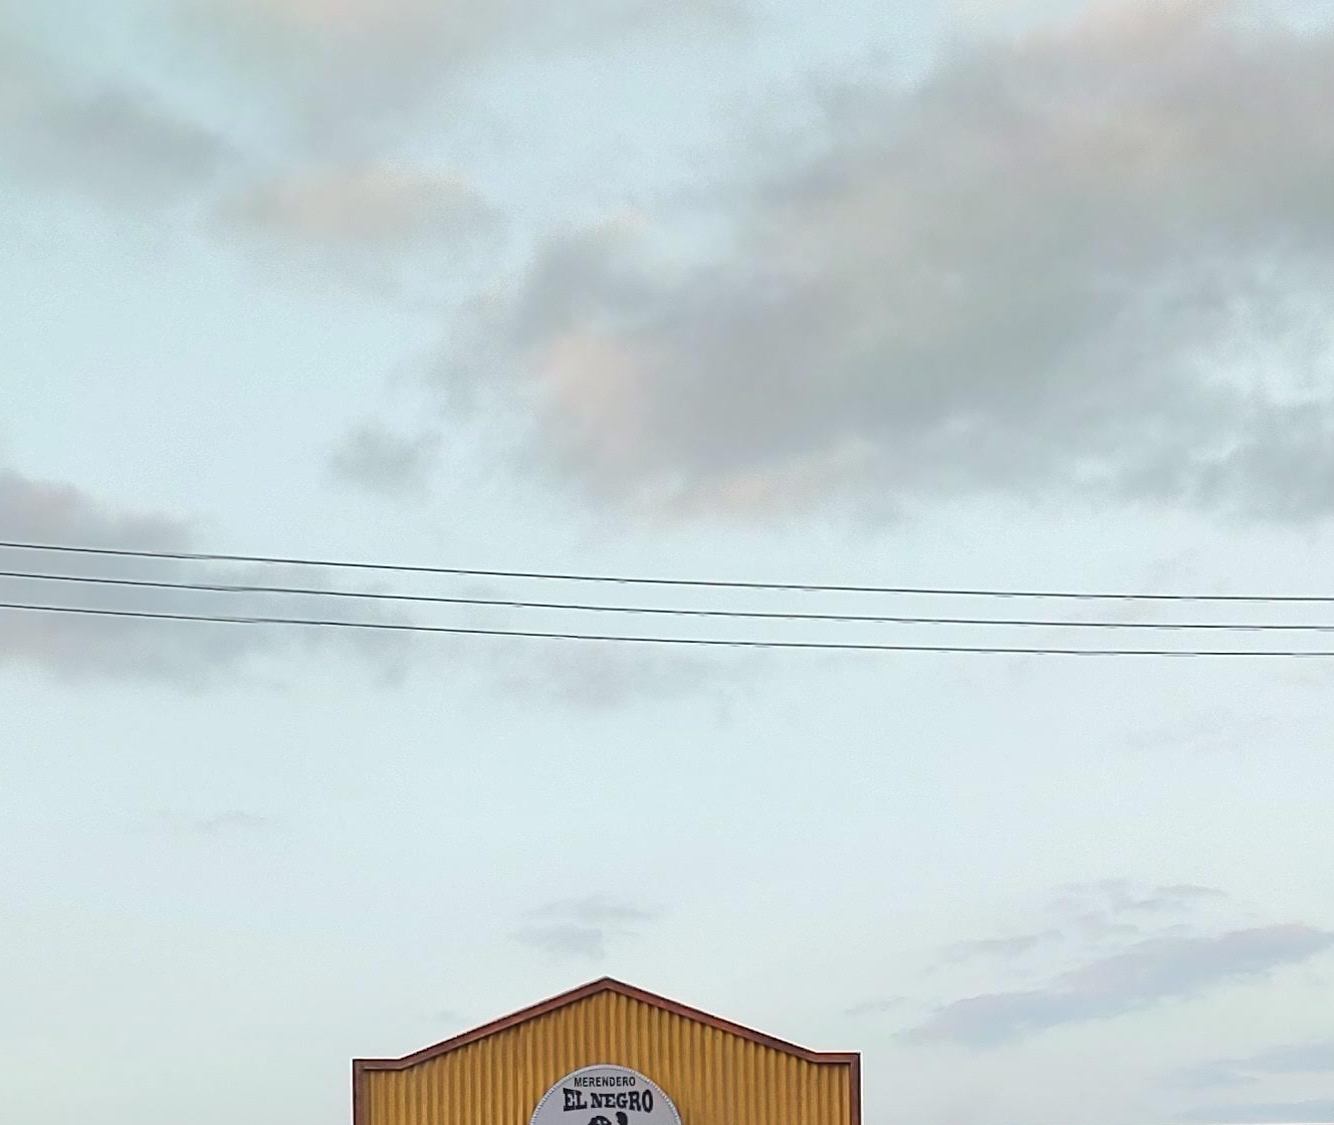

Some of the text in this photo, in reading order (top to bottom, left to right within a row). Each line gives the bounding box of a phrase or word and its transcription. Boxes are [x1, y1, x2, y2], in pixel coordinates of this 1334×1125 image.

[573, 1076, 636, 1088] MERENDERO
[562, 1087, 654, 1114] EL NEGRO
